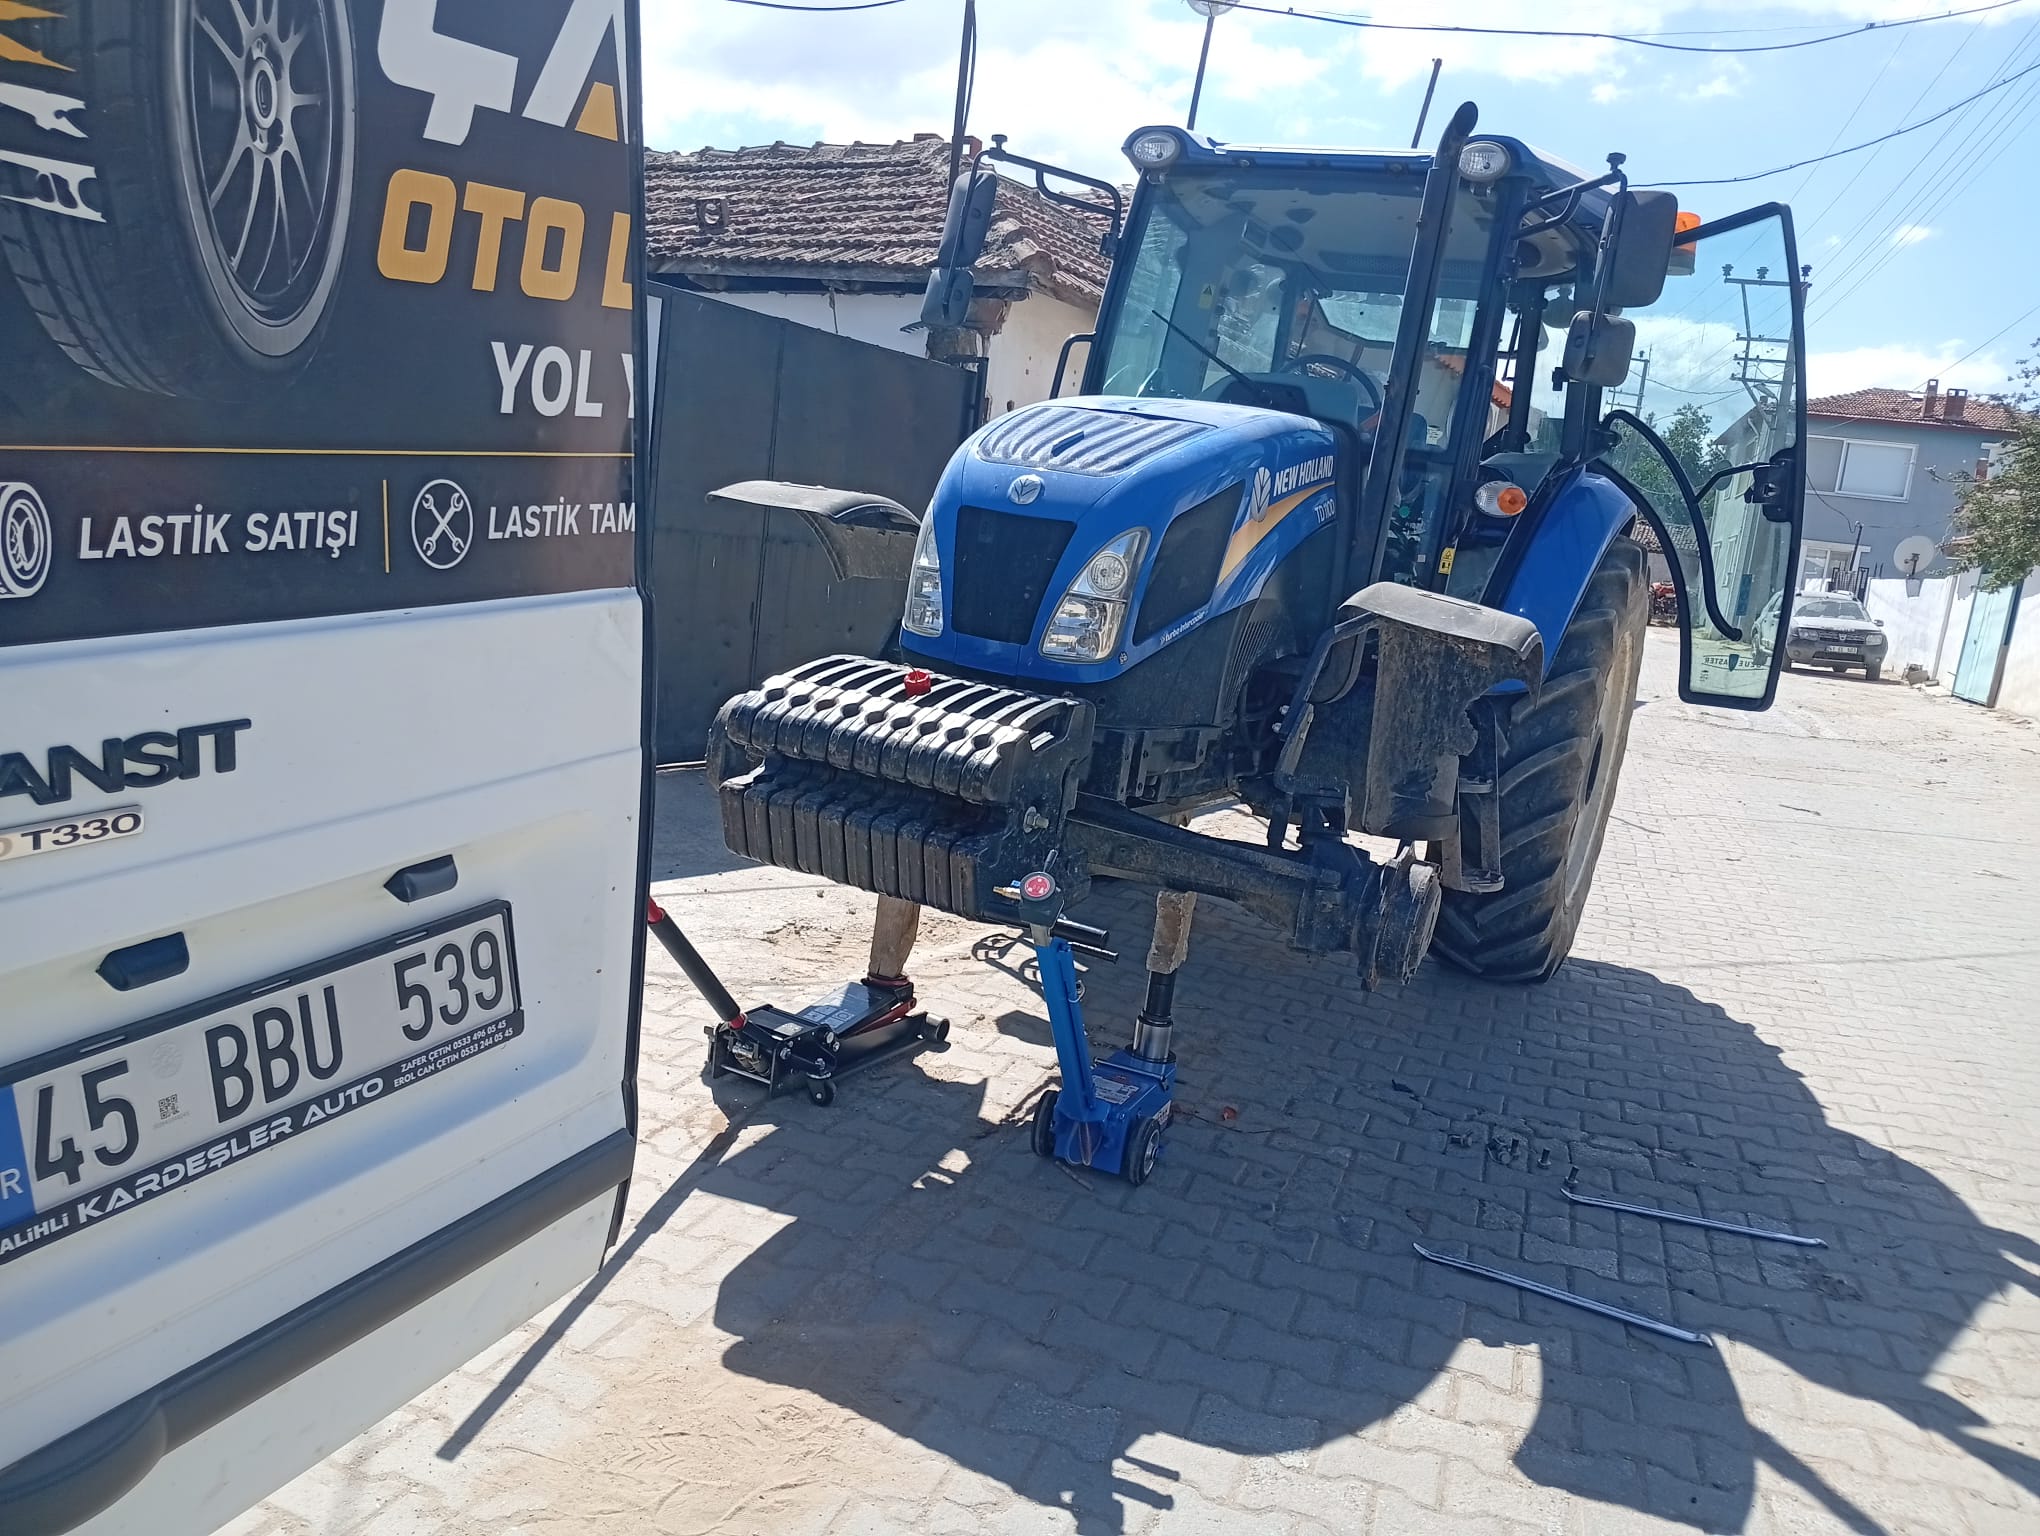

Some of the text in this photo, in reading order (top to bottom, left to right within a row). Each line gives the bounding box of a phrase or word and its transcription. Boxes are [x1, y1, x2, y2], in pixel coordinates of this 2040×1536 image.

[377, 169, 585, 301] OTO
[491, 341, 603, 418] YOL
[1273, 455, 1334, 497] NEW HOLLAND
[79, 503, 358, 559] LASTİK SATIŞI
[488, 496, 582, 540] LASTİK
[21, 813, 142, 851] T330
[34, 930, 504, 1186] 45 BBU 539
[394, 1072, 416, 1088] EROL
[417, 1063, 435, 1077] CAN
[460, 1044, 478, 1058] 0533
[494, 1031, 503, 1042] 05
[401, 1055, 430, 1072] ZAFER
[453, 1036, 471, 1050] 0533
[487, 1025, 496, 1035] 05
[77, 1116, 293, 1224] KARDEŞLER
[302, 1077, 384, 1127] AUTO
